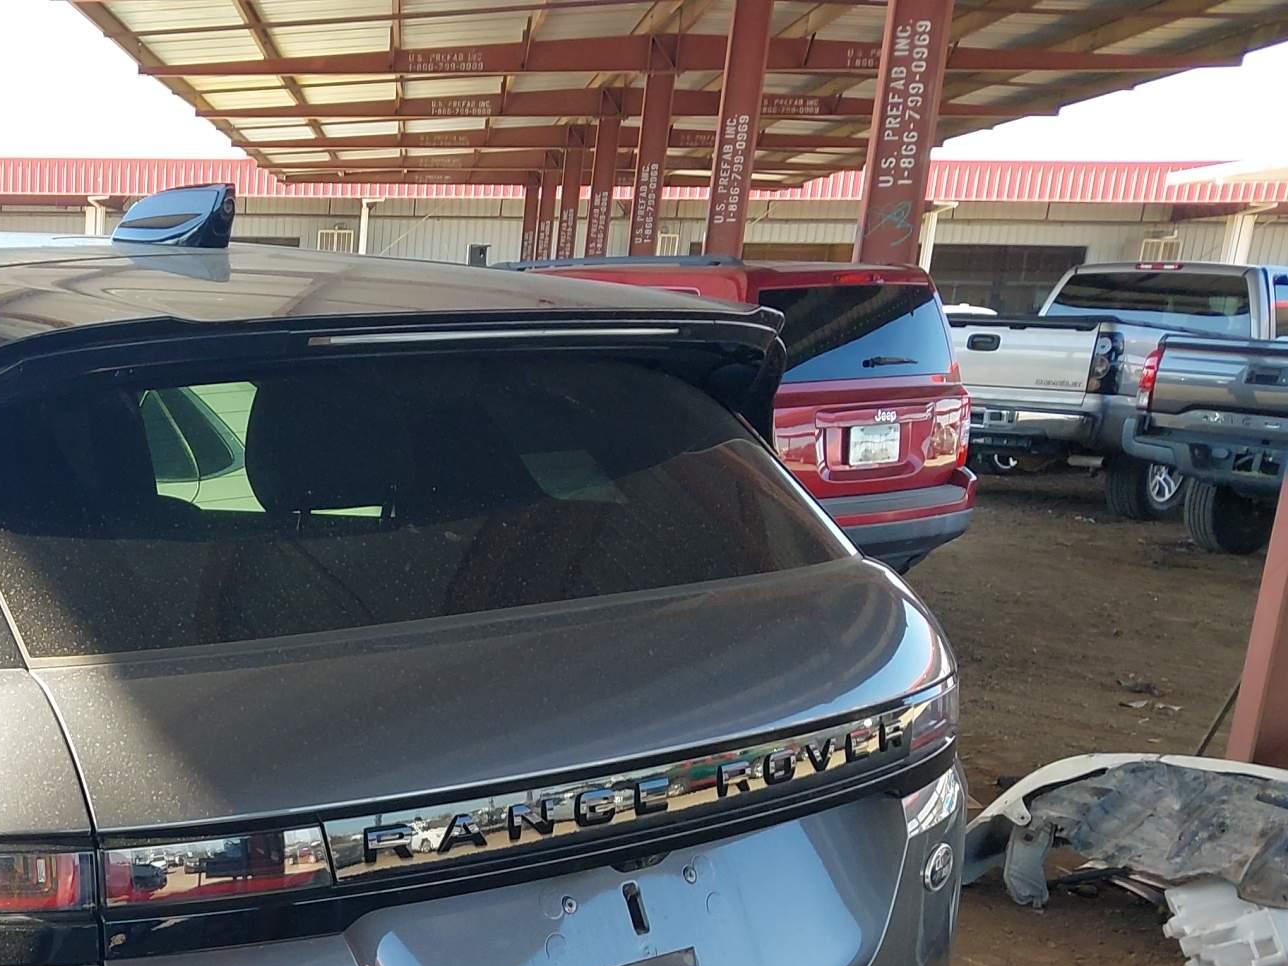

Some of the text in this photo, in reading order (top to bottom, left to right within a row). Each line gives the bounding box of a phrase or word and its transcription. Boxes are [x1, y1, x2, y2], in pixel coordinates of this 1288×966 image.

[878, 19, 913, 188] U.S. PREFAB INC.
[898, 20, 932, 185] 1-866-799-0969
[714, 114, 738, 223] U.S. PREFAB INC.
[726, 115, 749, 222] 1-866-799-0969
[874, 408, 897, 423] Jeep
[363, 716, 904, 864] RANGE ROVER
